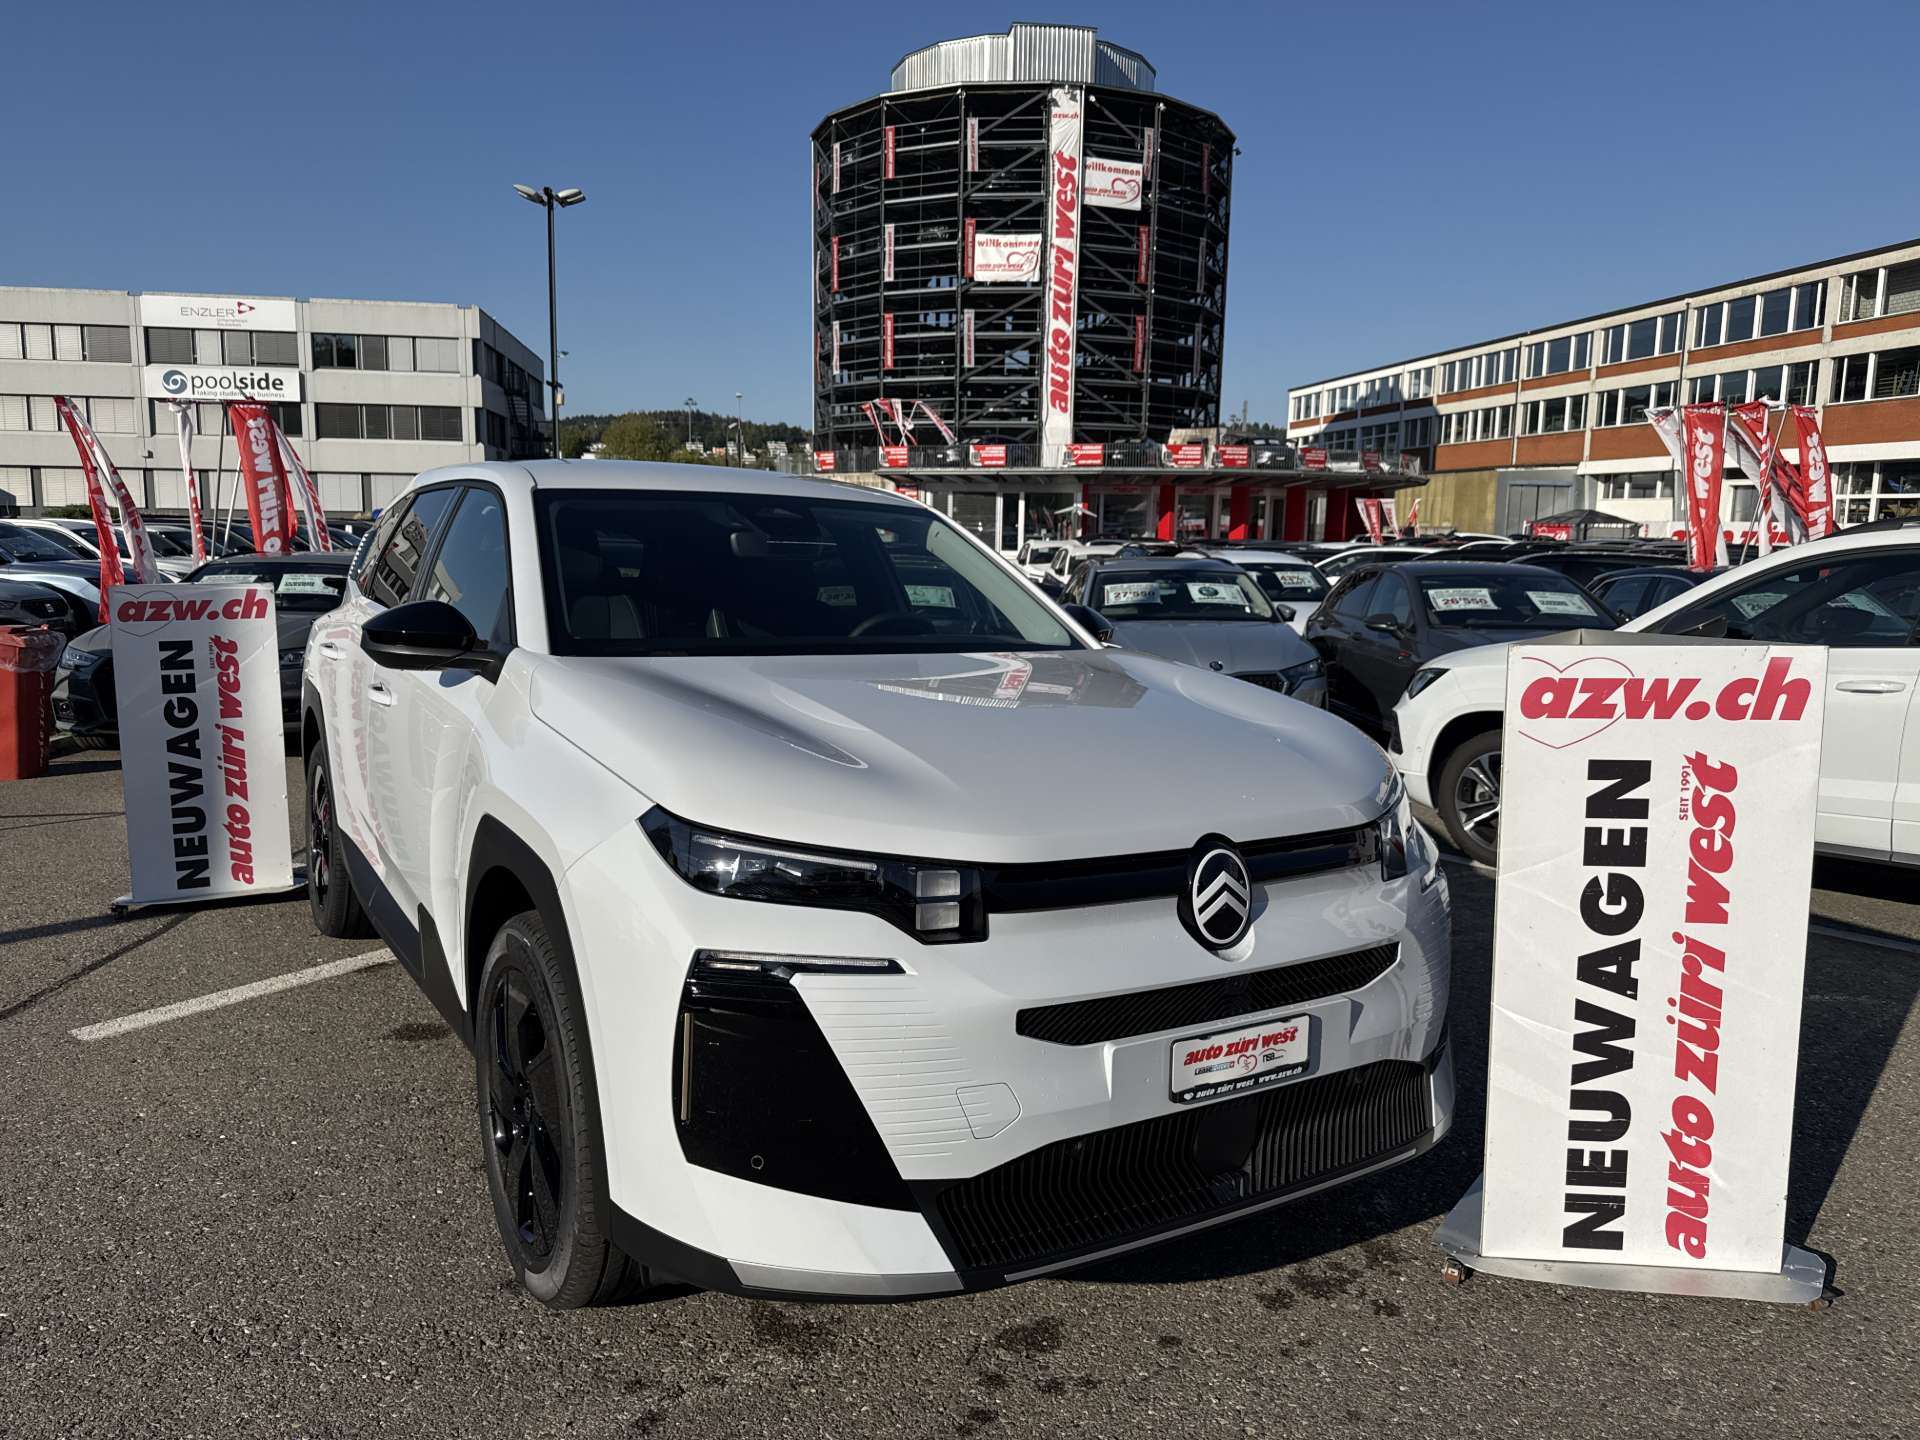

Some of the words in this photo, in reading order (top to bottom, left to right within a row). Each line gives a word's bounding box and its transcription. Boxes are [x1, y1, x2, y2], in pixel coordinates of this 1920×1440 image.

[1055, 150, 1078, 239] west
[180, 307, 235, 318] ENZLER
[191, 371, 284, 395] poolside
[1047, 328, 1071, 414] auto
[1693, 426, 1714, 500] west
[116, 588, 269, 622] azw.ch
[209, 634, 241, 720] west
[1519, 656, 1812, 721] azw.ch
[158, 640, 211, 891] NEUWAGEN
[214, 723, 249, 802] züri
[1680, 765, 1691, 793] 1991
[222, 803, 255, 886] auto
[1678, 797, 1690, 821] SEIT
[1681, 751, 1738, 925] west
[1562, 759, 1653, 1252] NEUWAGEN
[1666, 932, 1726, 1095] züri
[1183, 1043, 1224, 1066] auto
[1224, 1034, 1261, 1057] züri
[1262, 1028, 1298, 1048] west
[1195, 1089, 1215, 1099] auto
[1216, 1083, 1235, 1094] züri
[1236, 1079, 1255, 1090] west
[1258, 1066, 1303, 1083] www.azw.ch
[1662, 1095, 1715, 1260] auto
